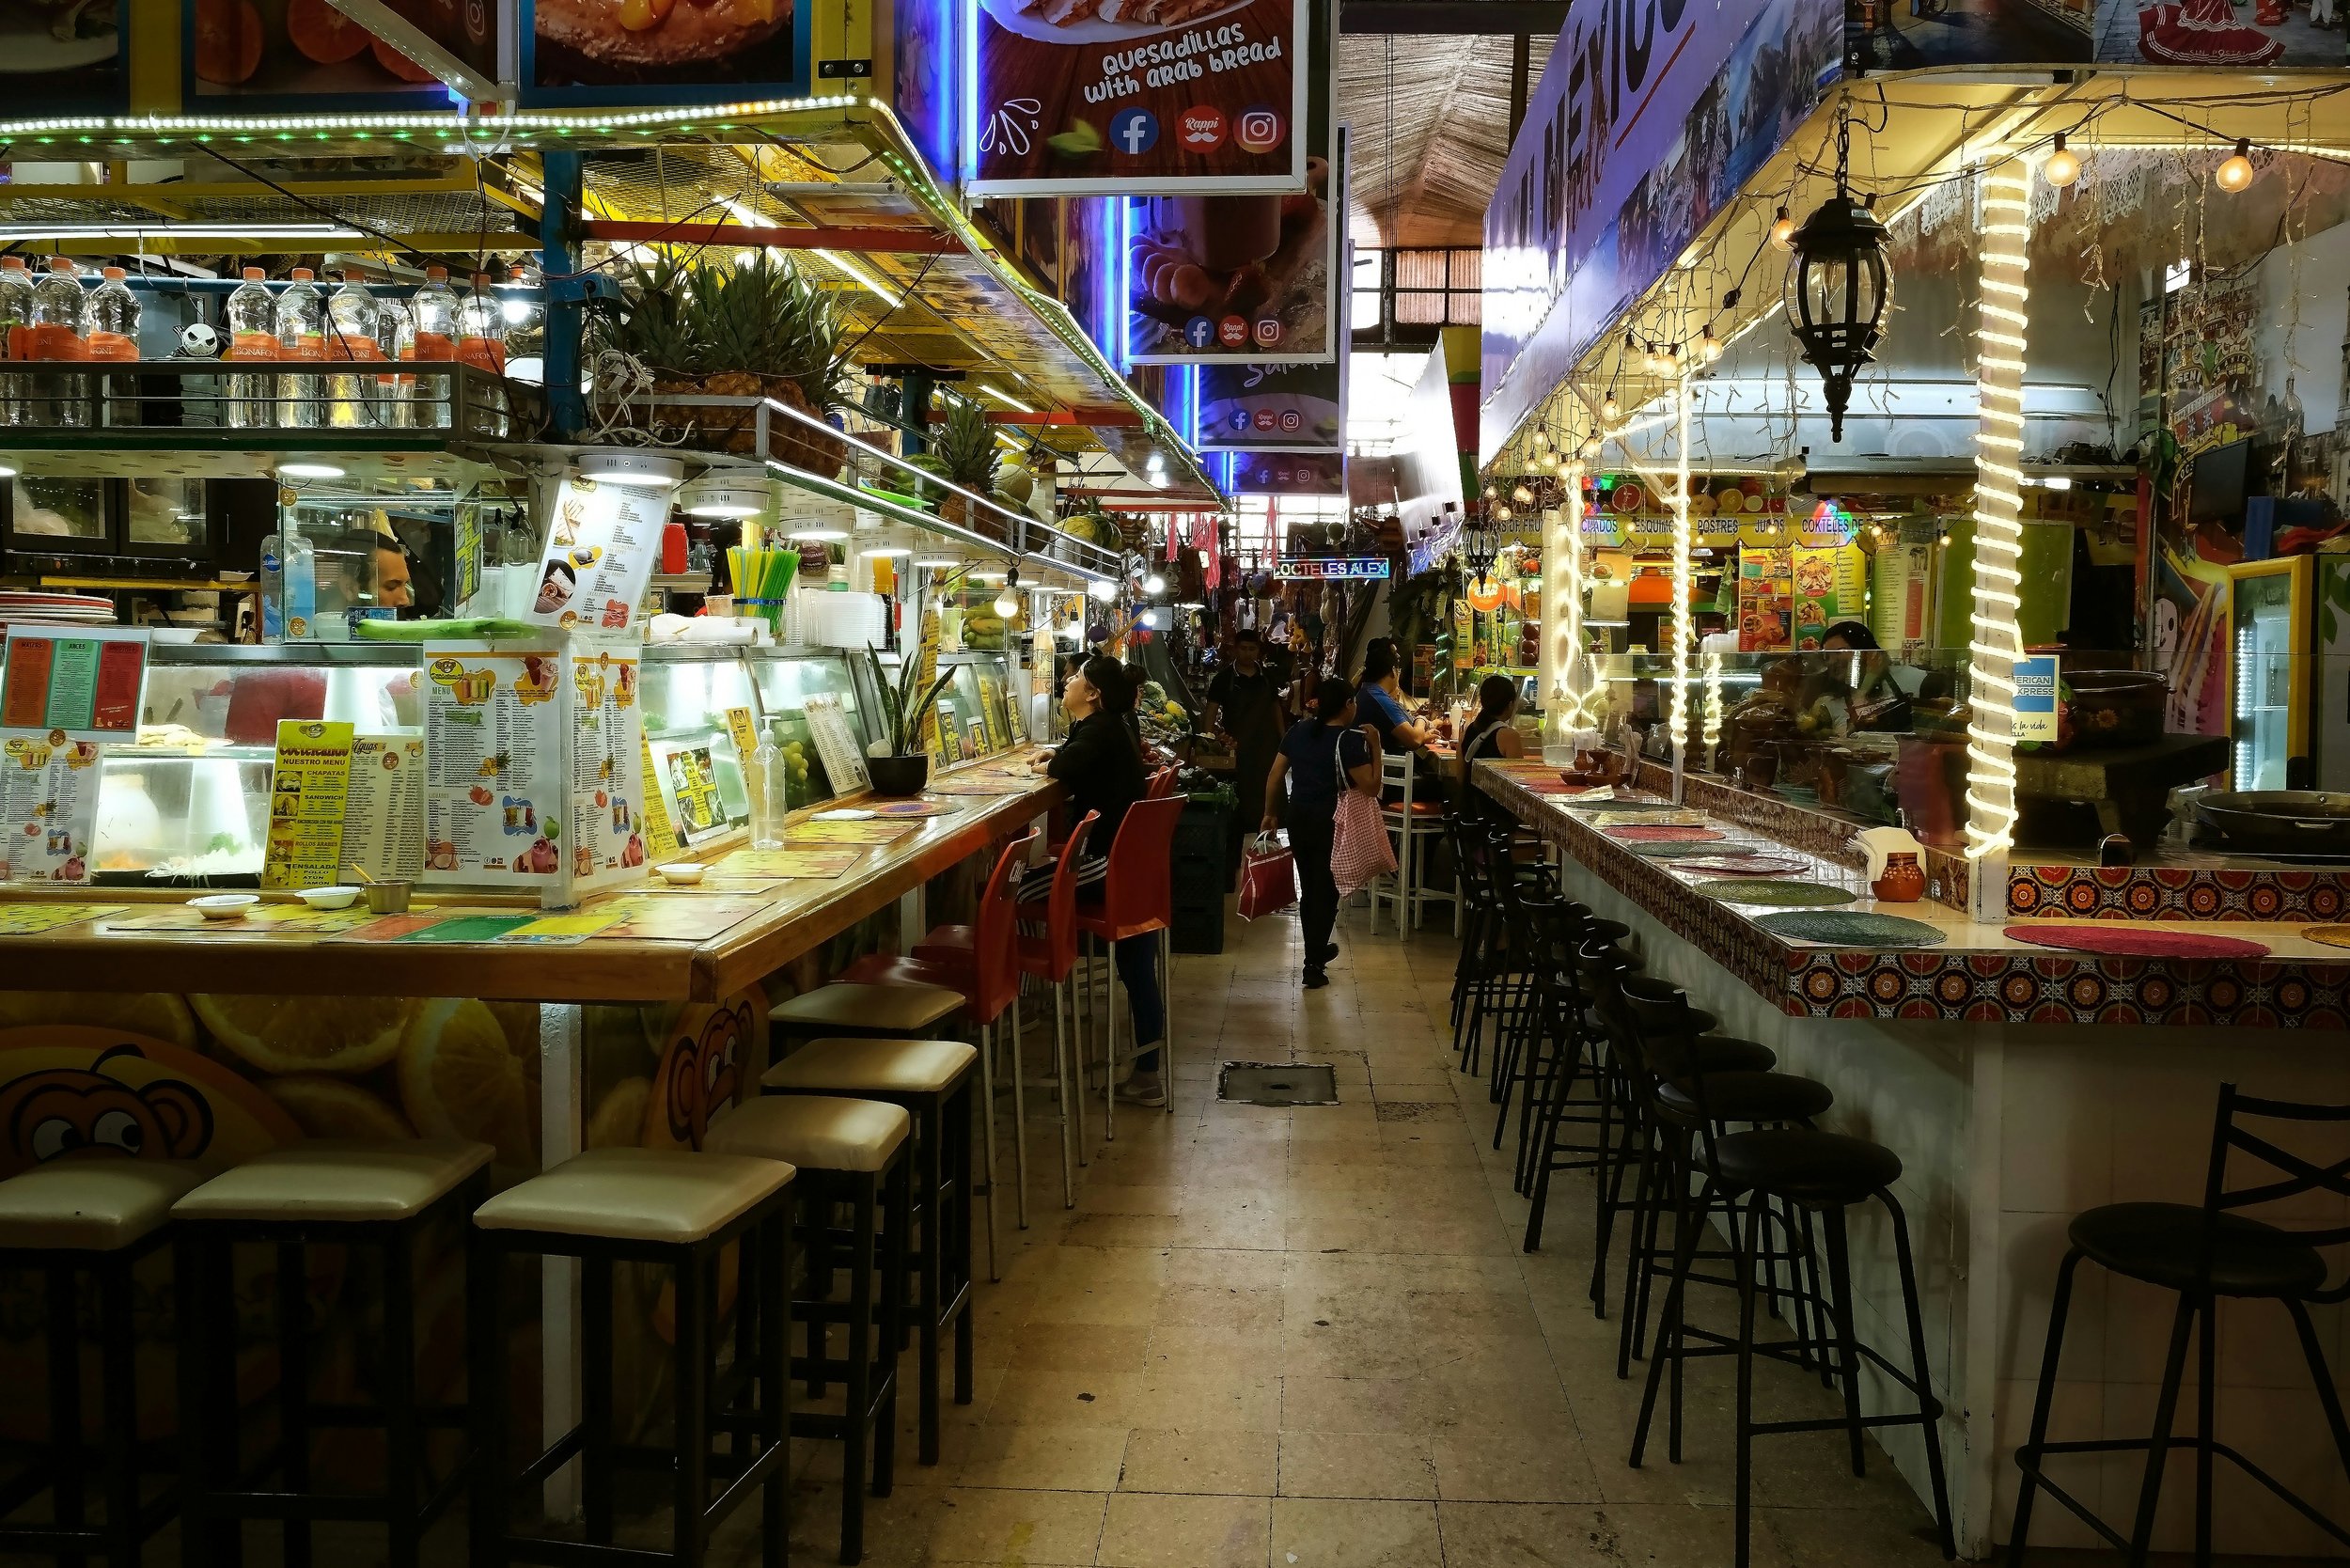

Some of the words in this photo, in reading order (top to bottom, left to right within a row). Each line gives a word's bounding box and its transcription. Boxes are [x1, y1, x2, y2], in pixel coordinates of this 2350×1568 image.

[1184, 117, 1219, 132] Rappi
[1223, 322, 1244, 332] Rappi
[1523, 519, 1543, 533] FRU
[1581, 519, 1618, 533] CUADOS
[1697, 519, 1739, 533] POSTRES
[1802, 519, 1849, 533] COKTELES
[1852, 519, 1863, 533] DE
[431, 686, 451, 696] MENU
